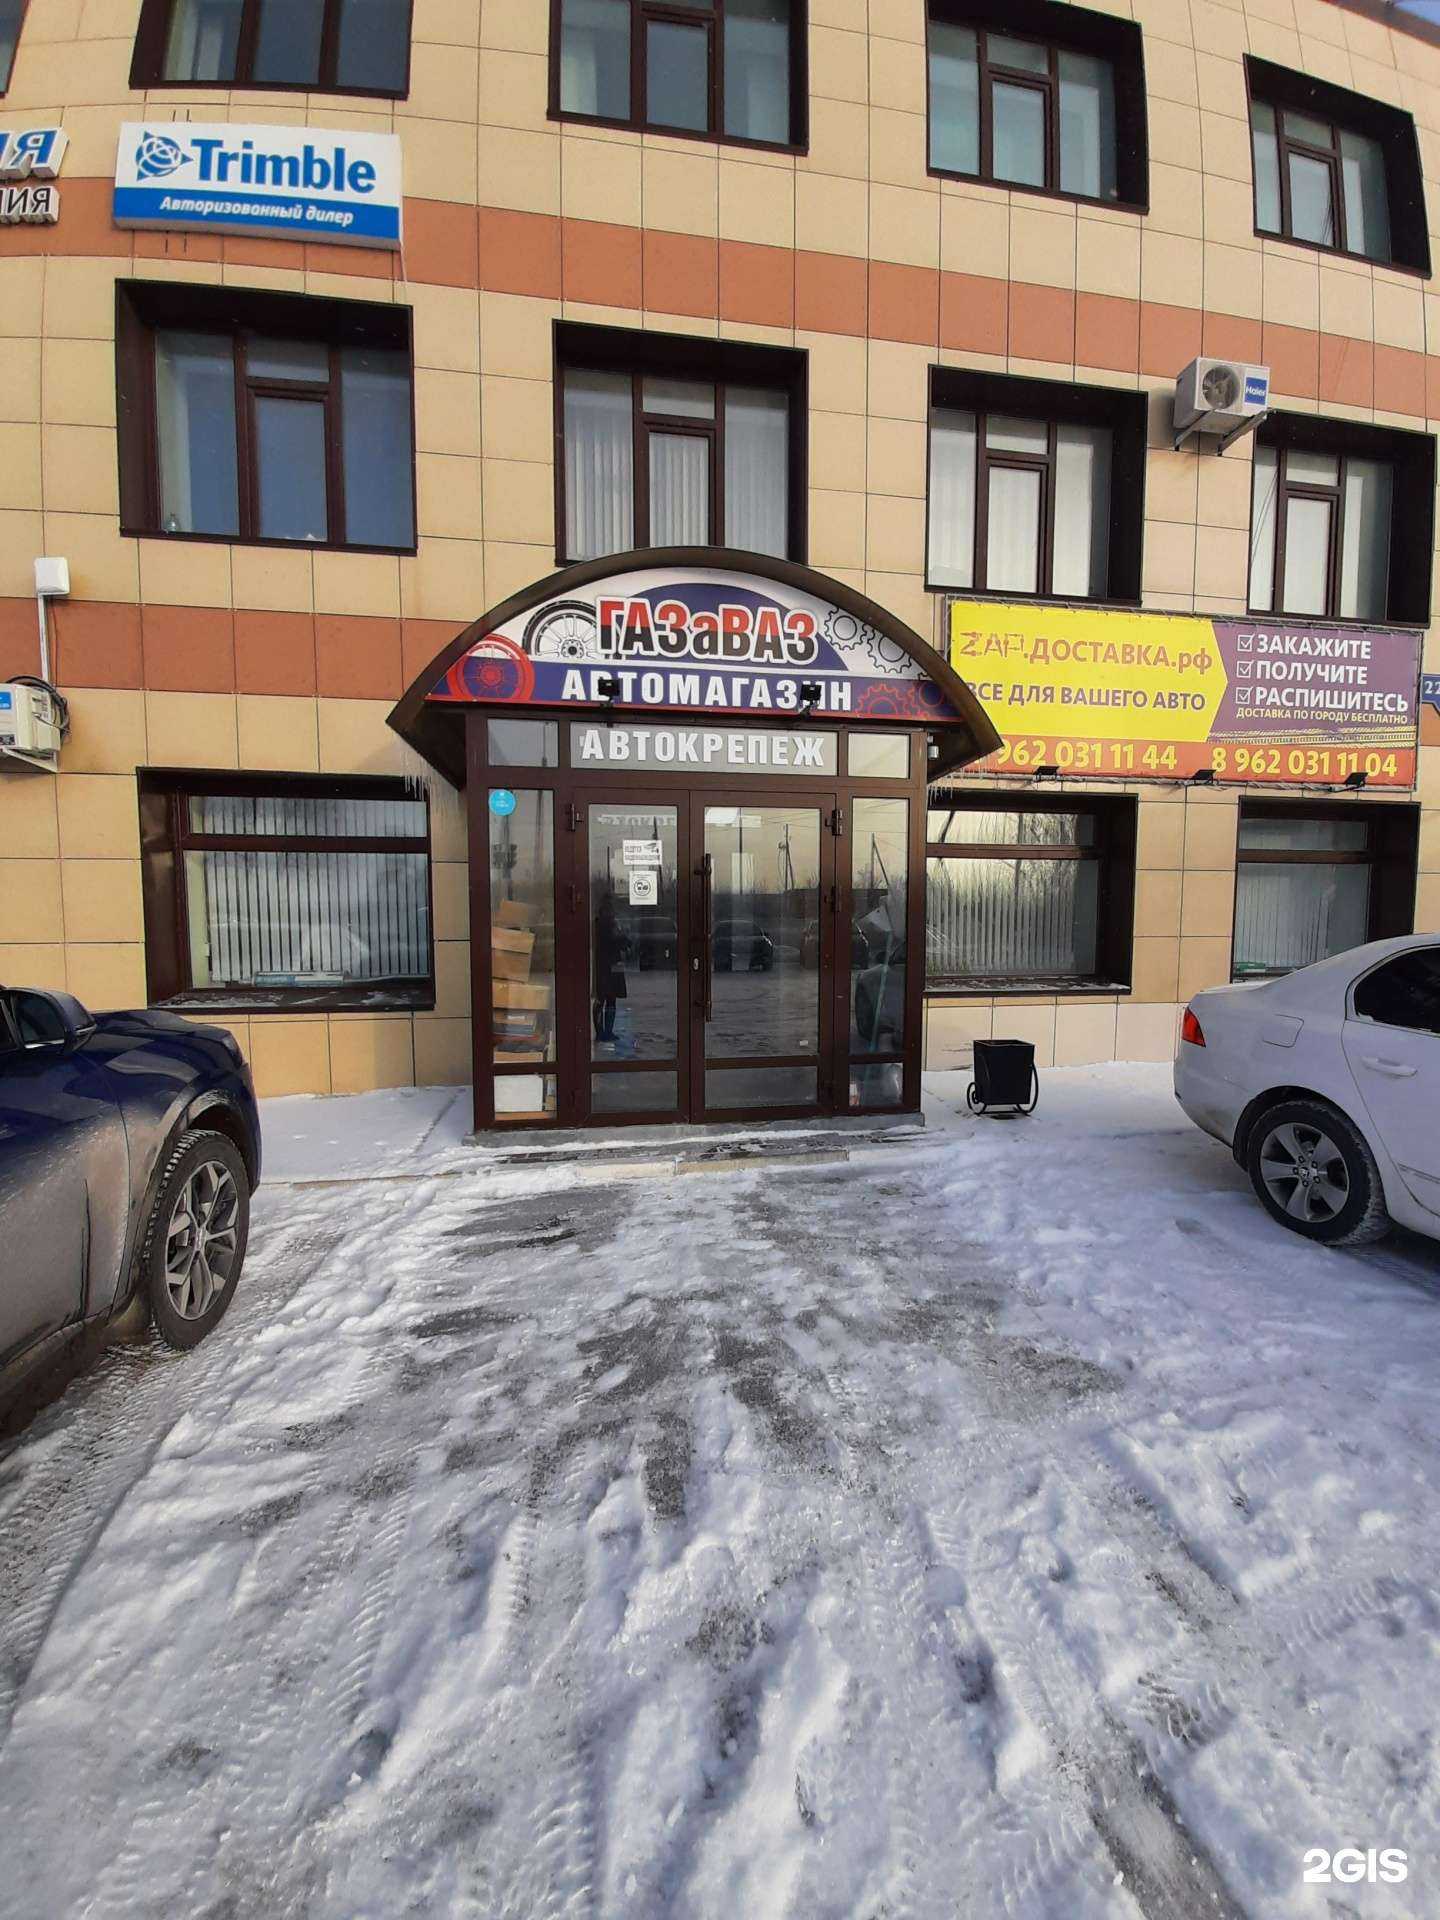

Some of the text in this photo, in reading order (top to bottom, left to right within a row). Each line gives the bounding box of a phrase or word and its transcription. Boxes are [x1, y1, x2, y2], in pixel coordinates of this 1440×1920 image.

[0, 130, 60, 170] Я
[190, 138, 377, 194] Trimble
[0, 185, 53, 215] ИЯ
[160, 196, 354, 226] Авторизованный дилер
[599, 600, 817, 662] ГАЗаВАЗ
[1256, 634, 1372, 660] ЗАКАЖИТЕ
[1255, 660, 1368, 685] ПОЛУЧИТЕ
[1008, 684, 1055, 706] ДЛЯ
[1060, 686, 1148, 709] ВАШЕГО
[1153, 691, 1206, 710] АВТО
[1255, 687, 1409, 712] РАСПИШИТЕСЬ
[1236, 707, 1408, 725] ДОСТАВКА ПО ГОРОДУ БЕСПЛАТНО
[581, 729, 825, 767] АВТОКРЕПЕЖ
[1055, 741, 1103, 769] 031
[1110, 744, 1135, 768] 11
[1142, 745, 1178, 770] 44
[1211, 747, 1398, 777] 8 962 031 11 04
